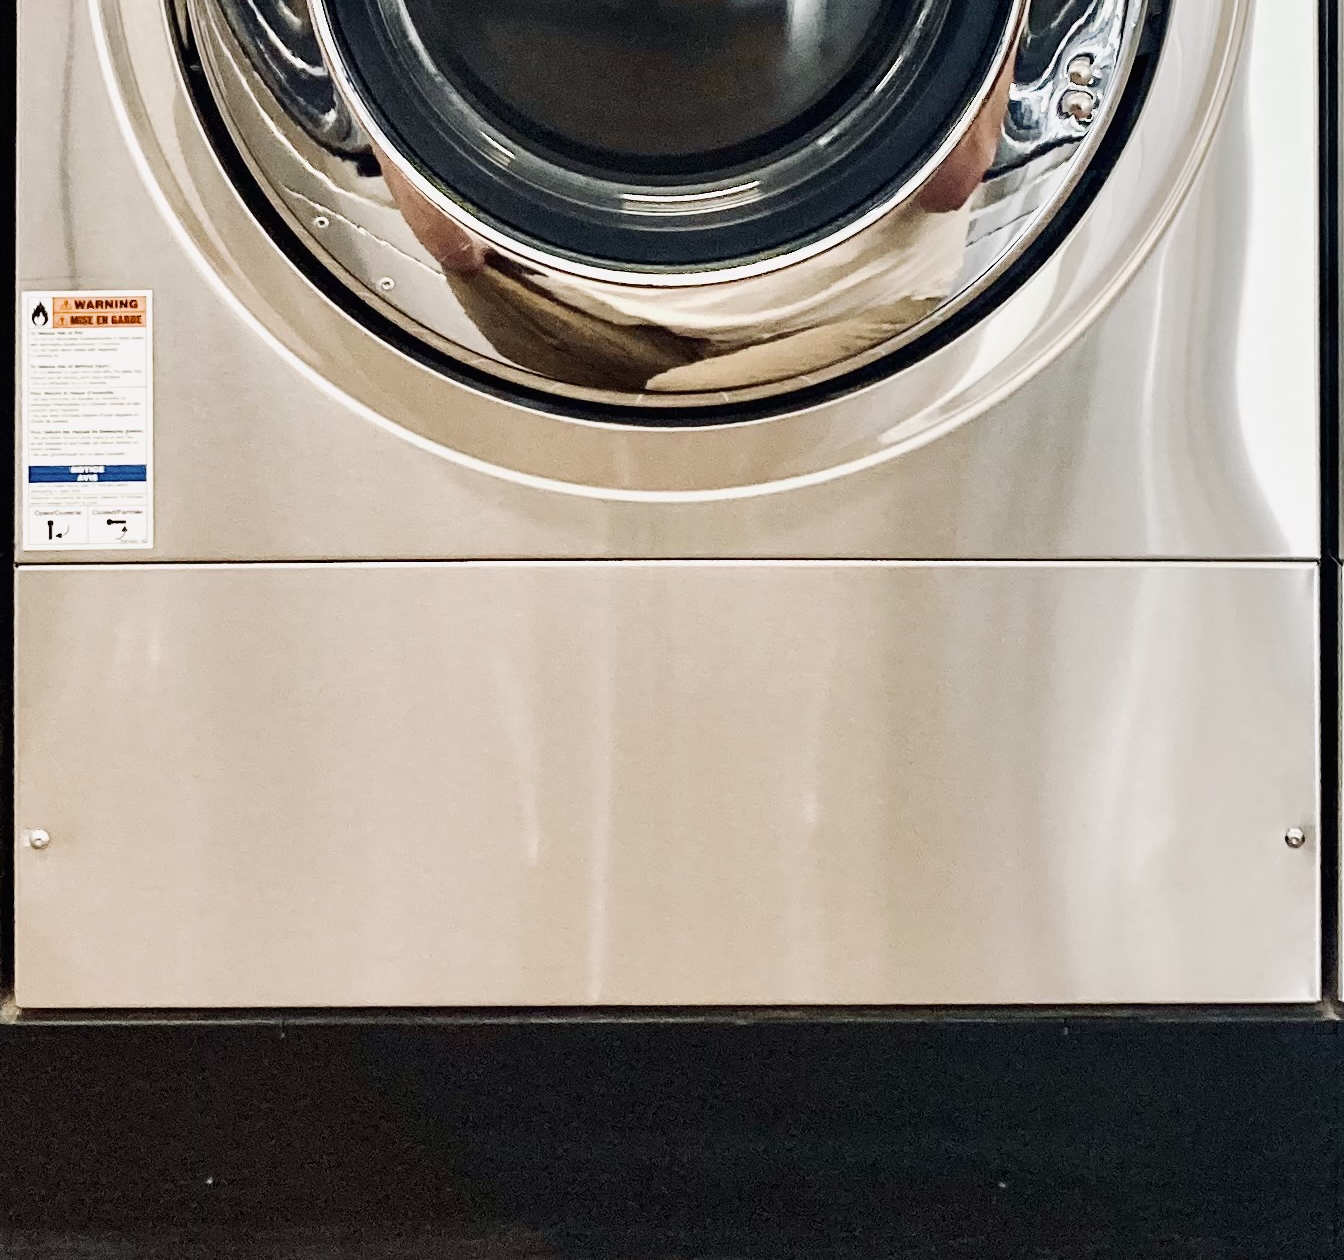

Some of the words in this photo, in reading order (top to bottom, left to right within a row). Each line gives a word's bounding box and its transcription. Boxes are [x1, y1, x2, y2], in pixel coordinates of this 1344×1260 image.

[74, 299, 138, 310] WARNING
[70, 315, 94, 325] MISE
[96, 315, 109, 325] EN
[111, 314, 142, 324] GARDE
